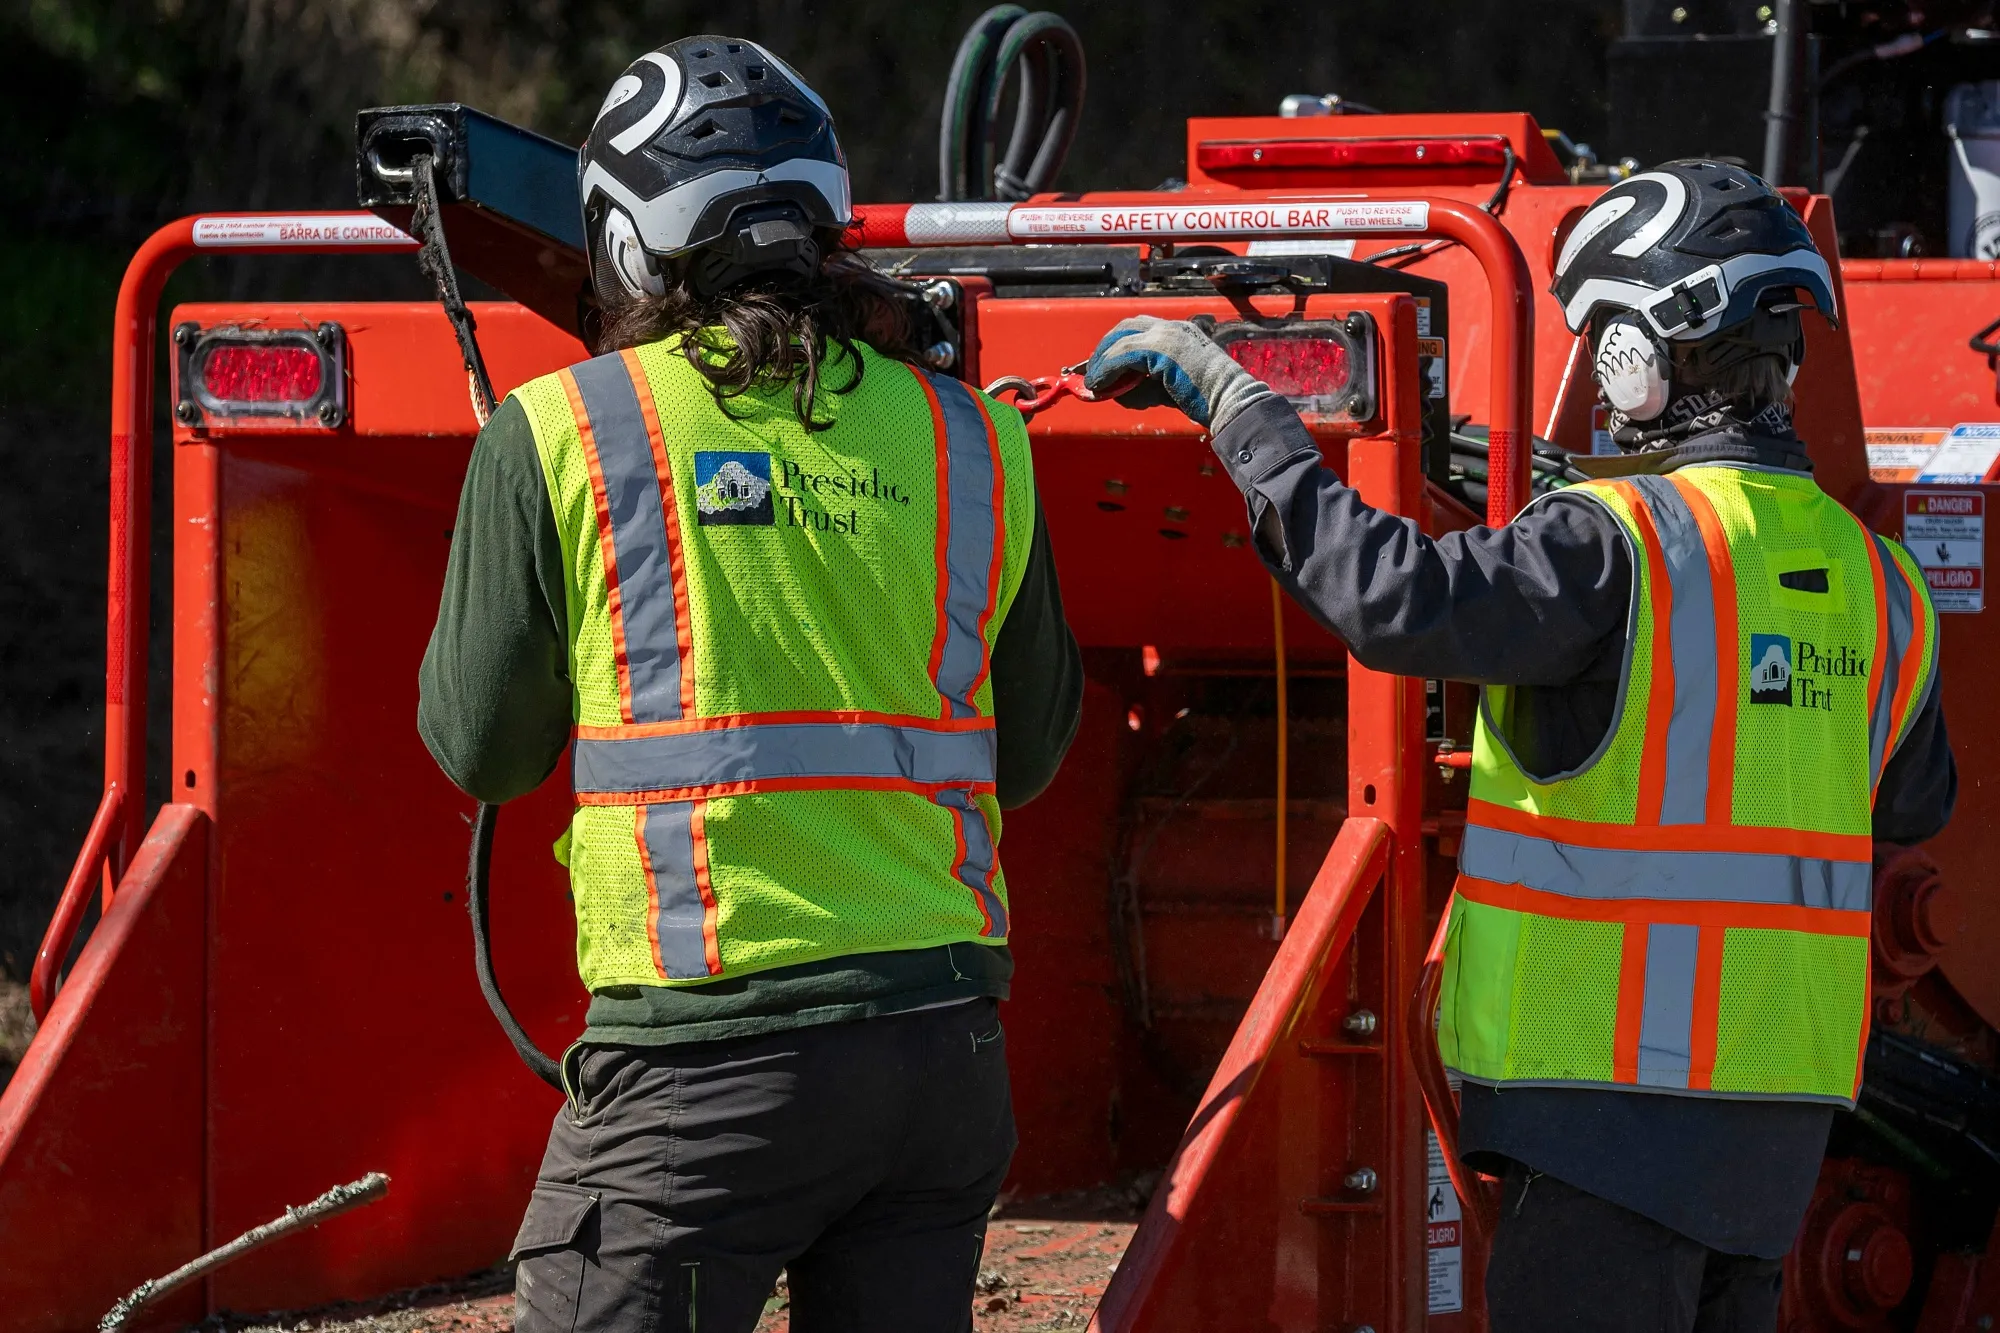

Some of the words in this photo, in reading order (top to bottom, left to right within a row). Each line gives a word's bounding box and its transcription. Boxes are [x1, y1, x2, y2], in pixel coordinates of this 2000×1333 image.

[1020, 213, 1042, 221] PUSH
[1044, 213, 1056, 221] TO
[1058, 213, 1095, 221] REVERSE
[1336, 207, 1358, 215] PUSH
[1361, 207, 1372, 215] TO
[1374, 206, 1412, 214] REVERSE
[1028, 224, 1051, 232] FEED
[1052, 224, 1086, 232] WHEELS
[1101, 211, 1179, 232] SAFETY
[1184, 210, 1281, 230] CONTROL
[1287, 209, 1331, 228] BAR
[1344, 217, 1366, 226] FEED
[1367, 217, 1403, 226] WHEELS
[280, 226, 321, 240] BARRA
[324, 226, 339, 240] DE
[342, 226, 399, 240] CONTROL
[1927, 496, 1973, 513] DANGER
[780, 495, 860, 536] Trust
[1927, 570, 1975, 588] PELIGRO
[1428, 1226, 1455, 1245] ELIGRO
